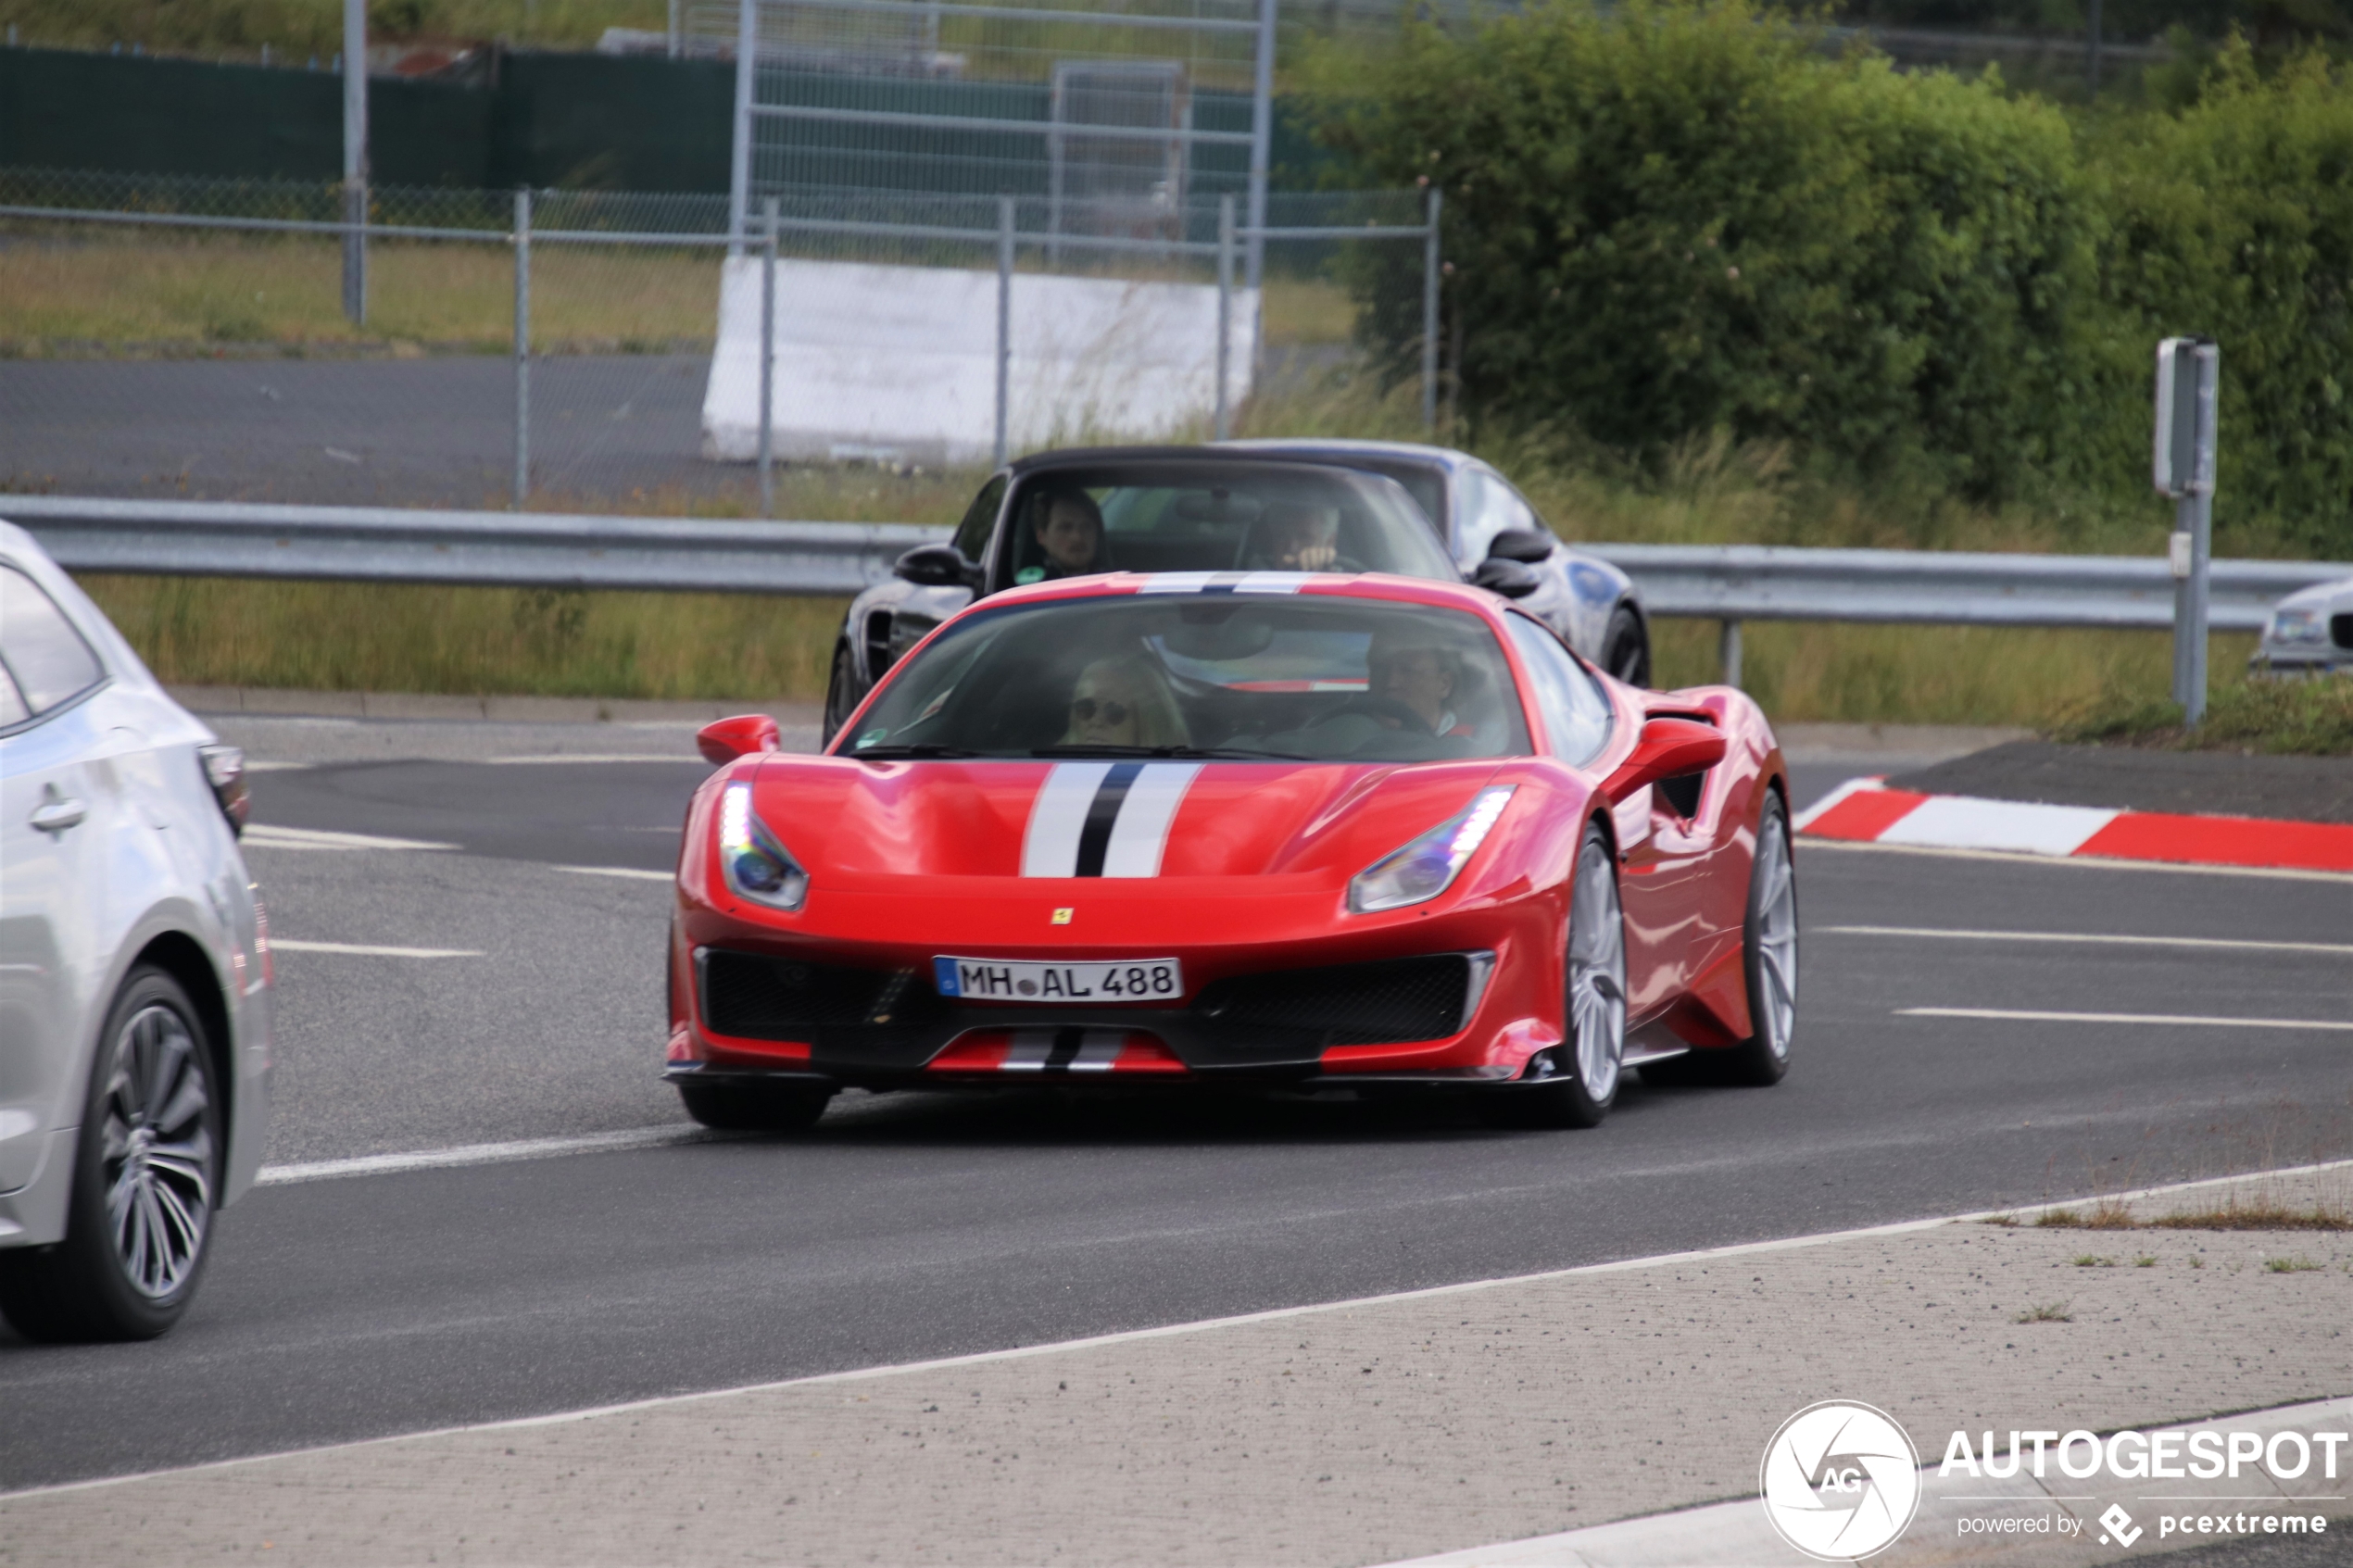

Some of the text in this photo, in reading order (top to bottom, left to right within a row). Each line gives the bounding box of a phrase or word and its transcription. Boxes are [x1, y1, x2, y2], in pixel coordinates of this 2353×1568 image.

[960, 964, 1174, 997] MH AL 488
